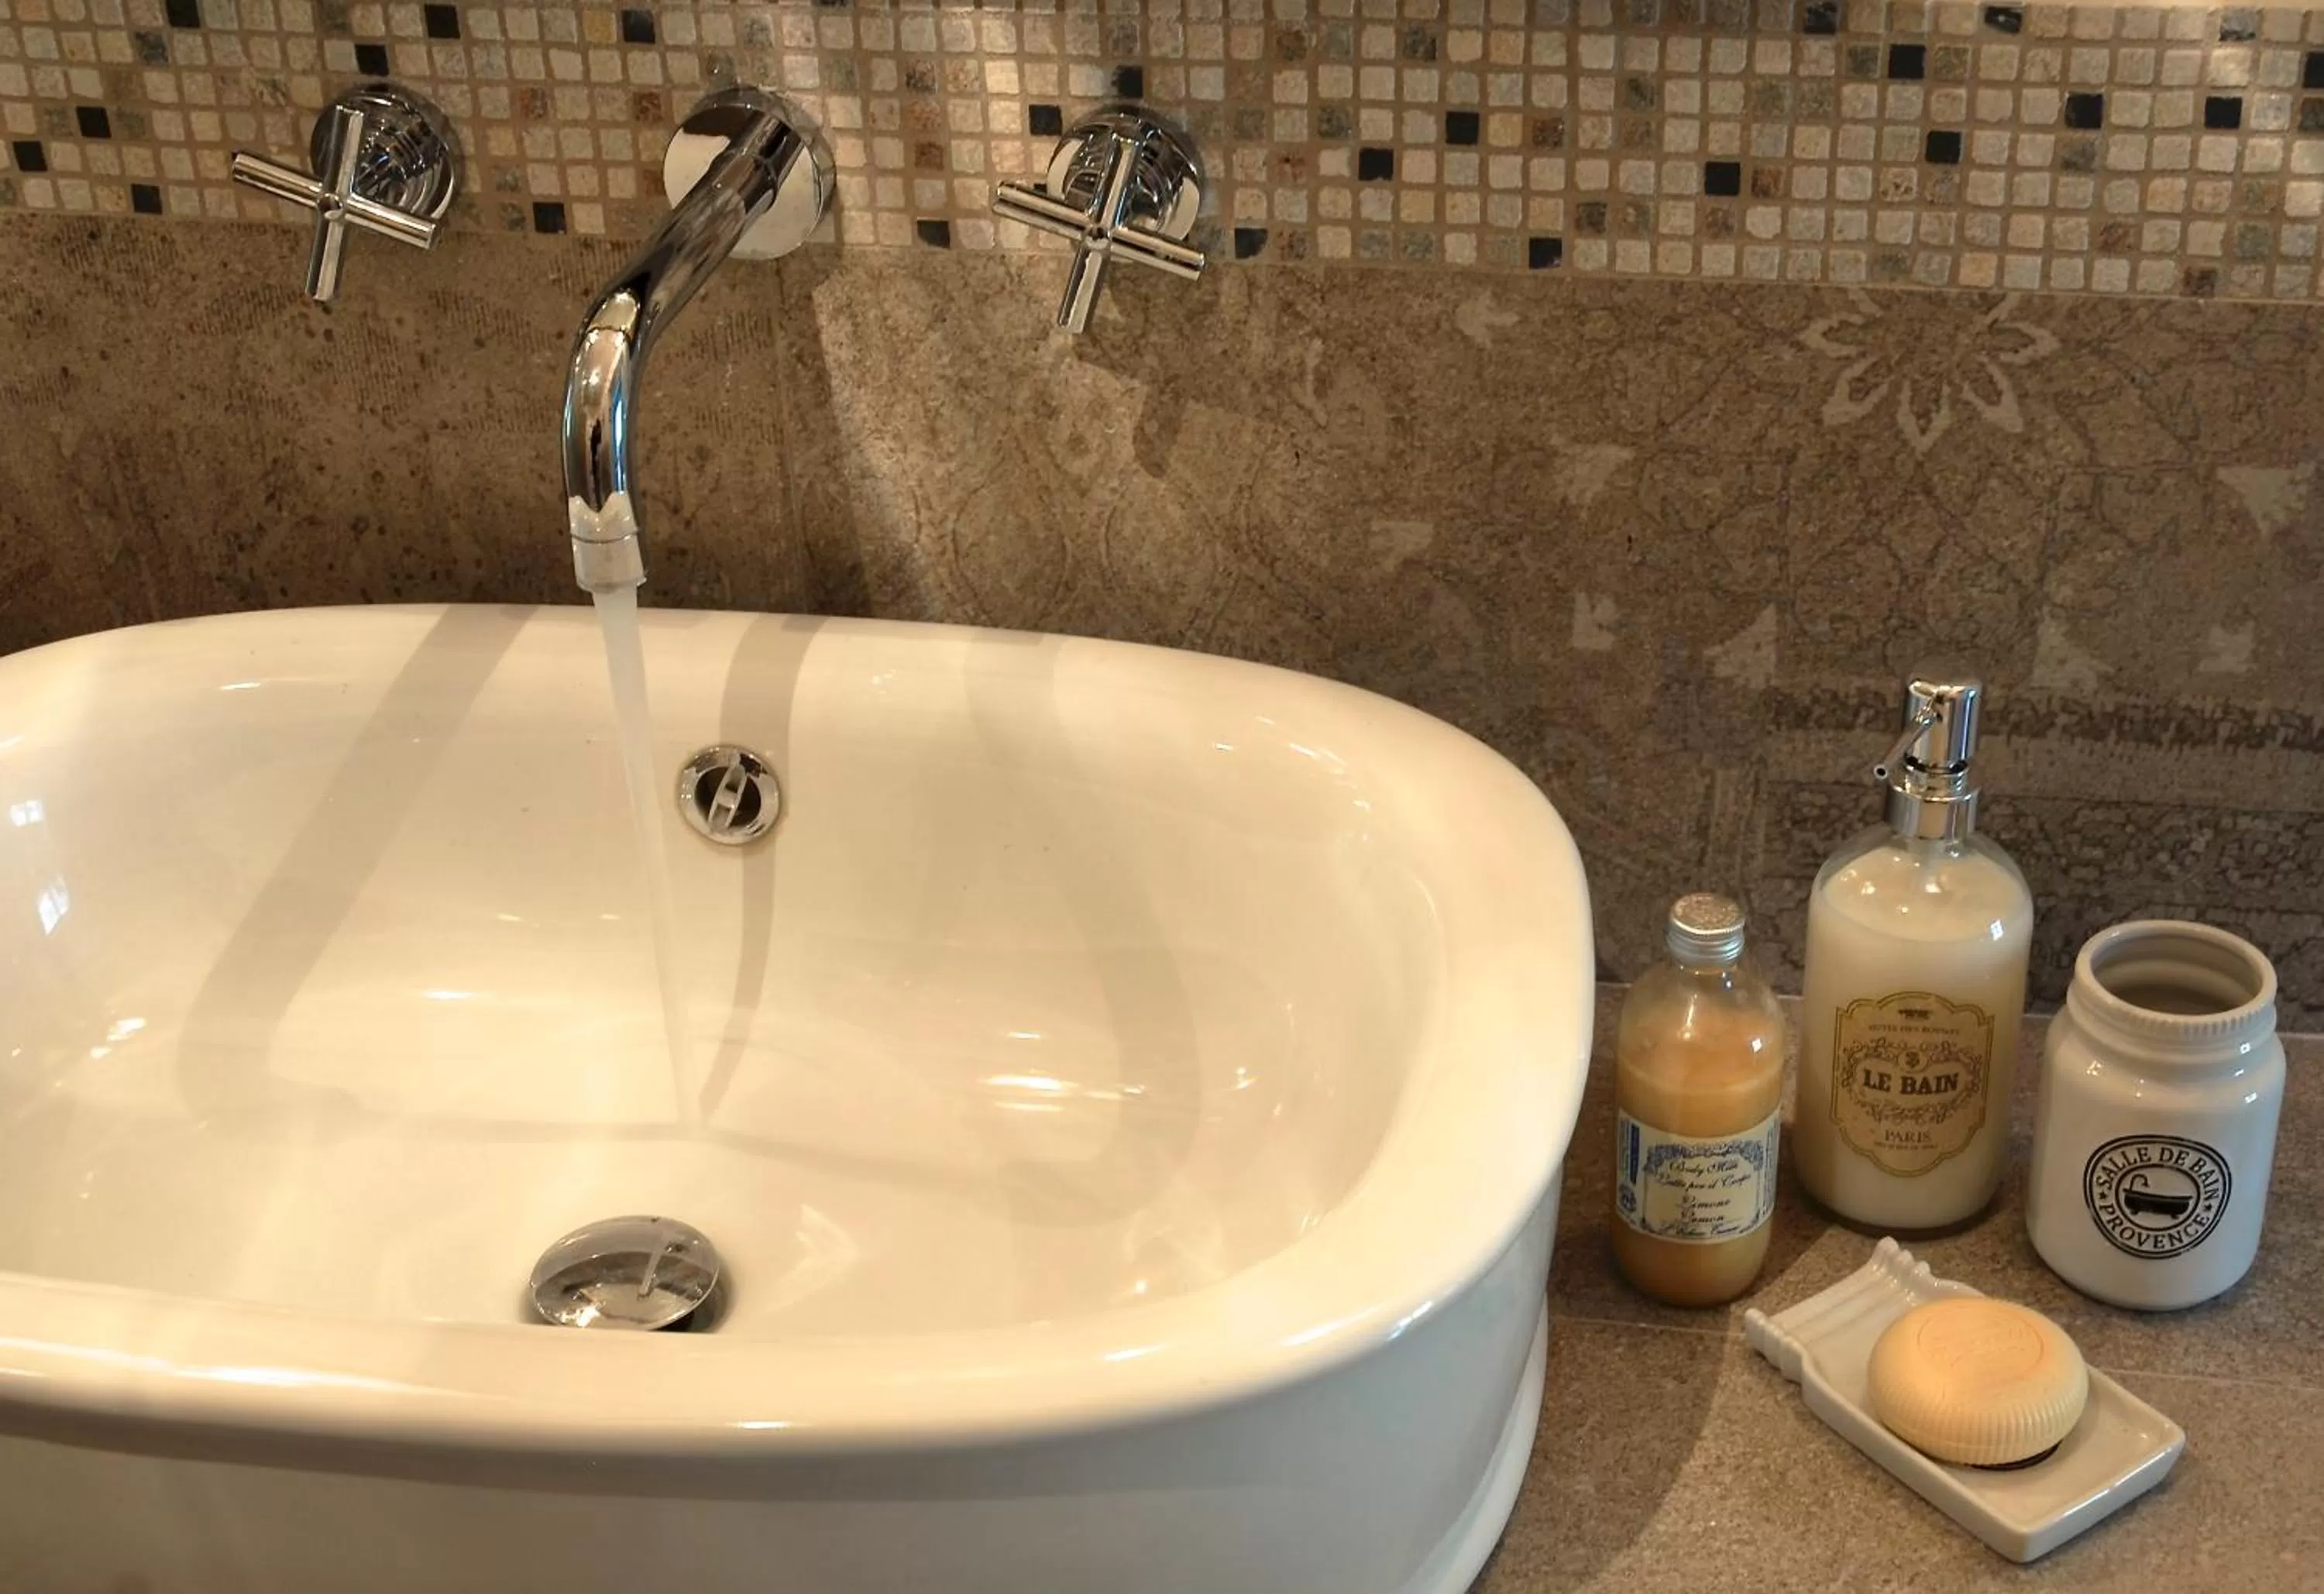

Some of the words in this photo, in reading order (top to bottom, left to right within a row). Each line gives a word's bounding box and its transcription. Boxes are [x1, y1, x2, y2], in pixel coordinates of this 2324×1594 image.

[1862, 1068, 1892, 1093] LE
[1900, 1072, 1959, 1095] BAIN
[1884, 1129, 1932, 1143] PARIS
[2096, 1146, 2151, 1190] SALLE
[2159, 1146, 2190, 1166] DE
[2189, 1157, 2220, 1201] BAIN
[2099, 1202, 2210, 1249] PROVENCE
